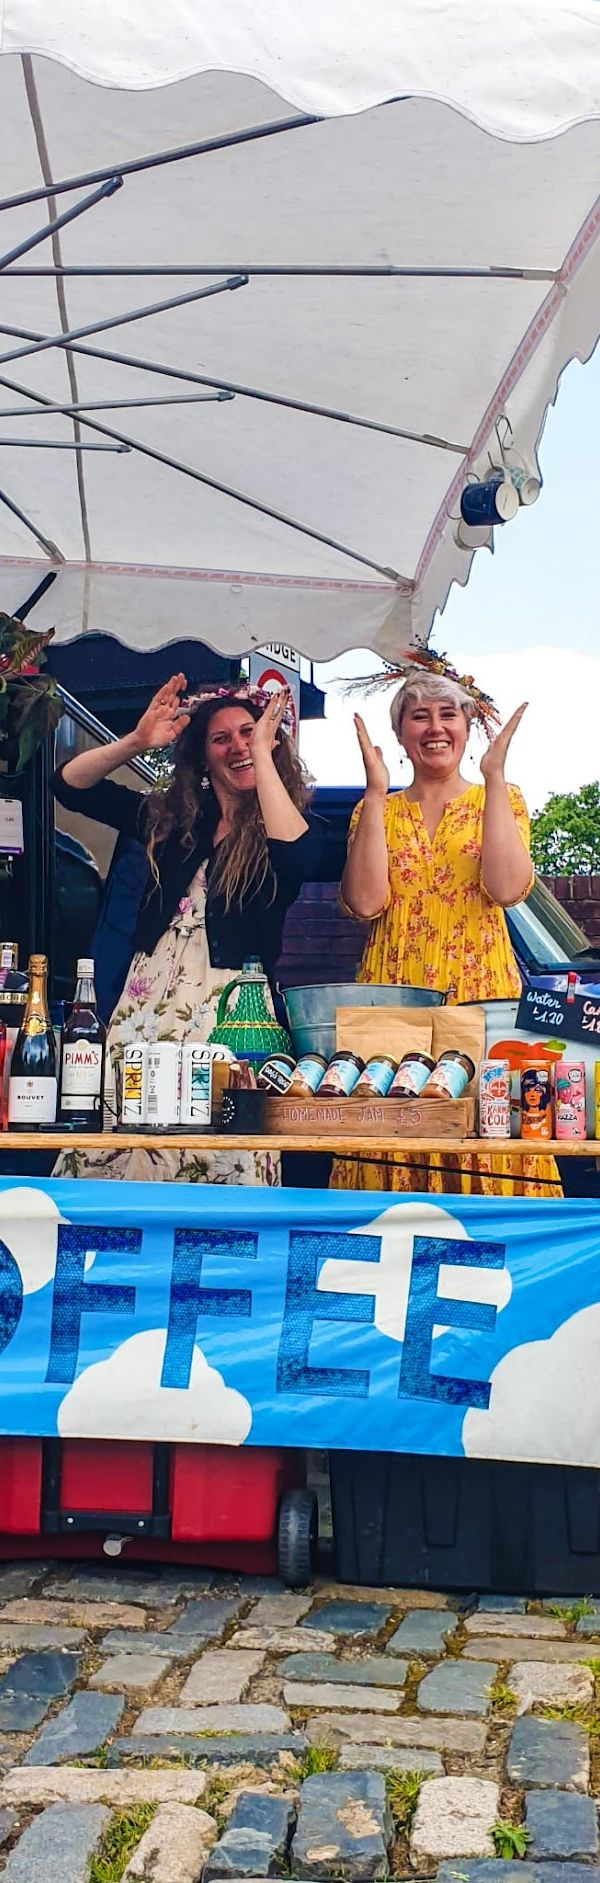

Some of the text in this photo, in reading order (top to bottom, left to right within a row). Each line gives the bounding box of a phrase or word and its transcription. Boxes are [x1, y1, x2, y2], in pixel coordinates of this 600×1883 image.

[527, 991, 562, 1009] Water
[65, 1051, 99, 1065] PIMM'S
[124, 1050, 143, 1116] SPRITZ
[190, 1050, 211, 1117] SPRITZ
[282, 1107, 345, 1122] HOMEMADE
[357, 1107, 384, 1122] JAM
[0, 1224, 506, 1410] FFEE
